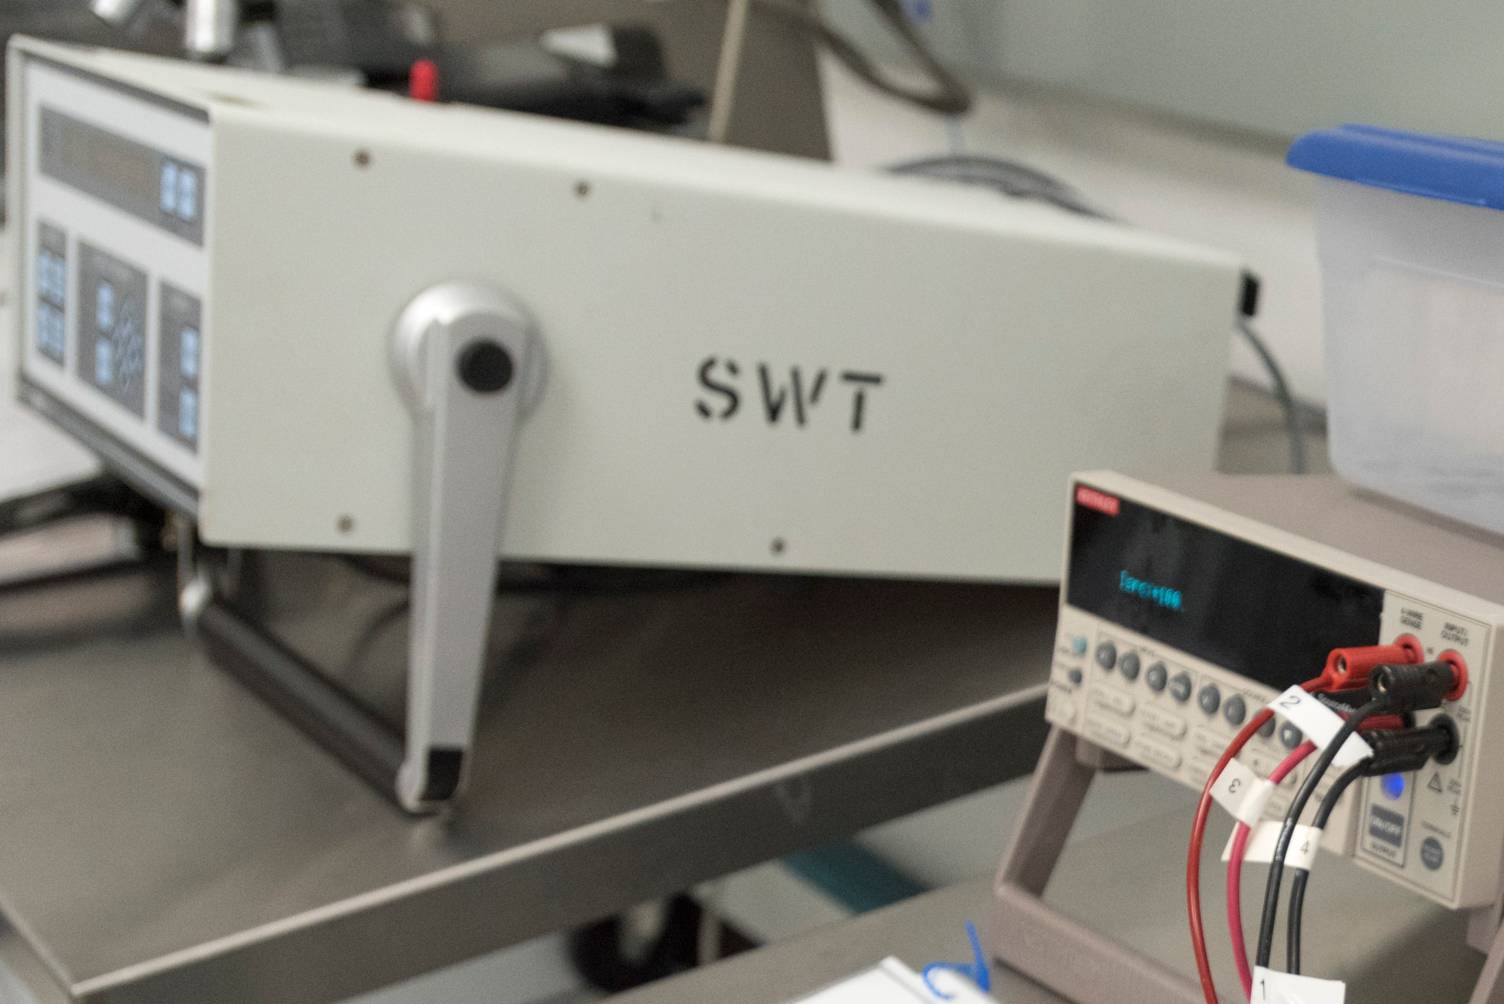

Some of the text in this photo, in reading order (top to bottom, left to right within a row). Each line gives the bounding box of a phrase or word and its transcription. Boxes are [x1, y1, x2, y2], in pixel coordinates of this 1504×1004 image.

[695, 356, 884, 433] SWT
[1279, 695, 1301, 709] 2
[1228, 778, 1241, 794] 3
